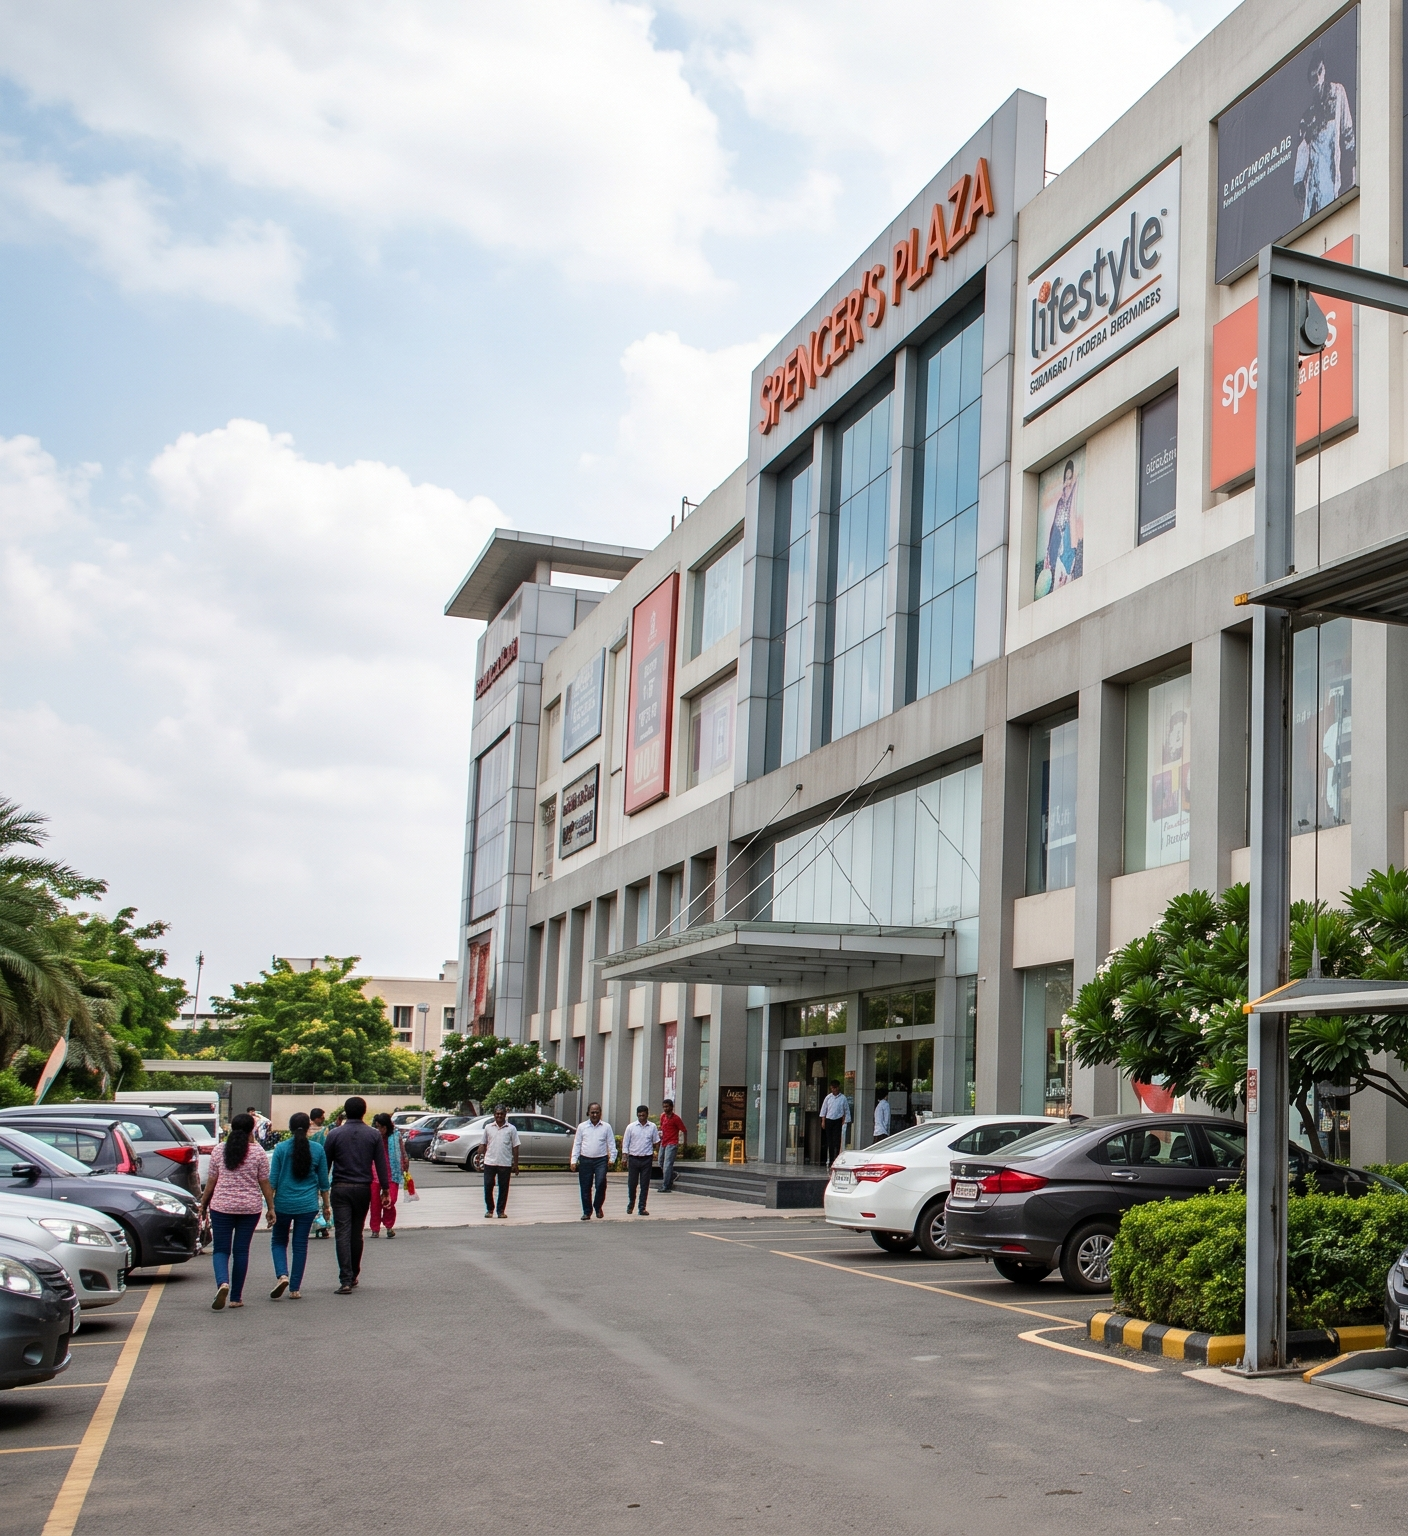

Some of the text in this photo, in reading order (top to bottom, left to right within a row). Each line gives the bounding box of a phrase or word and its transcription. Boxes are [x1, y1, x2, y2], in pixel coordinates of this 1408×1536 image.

[758, 157, 995, 435] SPENCER'S PLAZA
[1031, 211, 1164, 360] lifestyle
